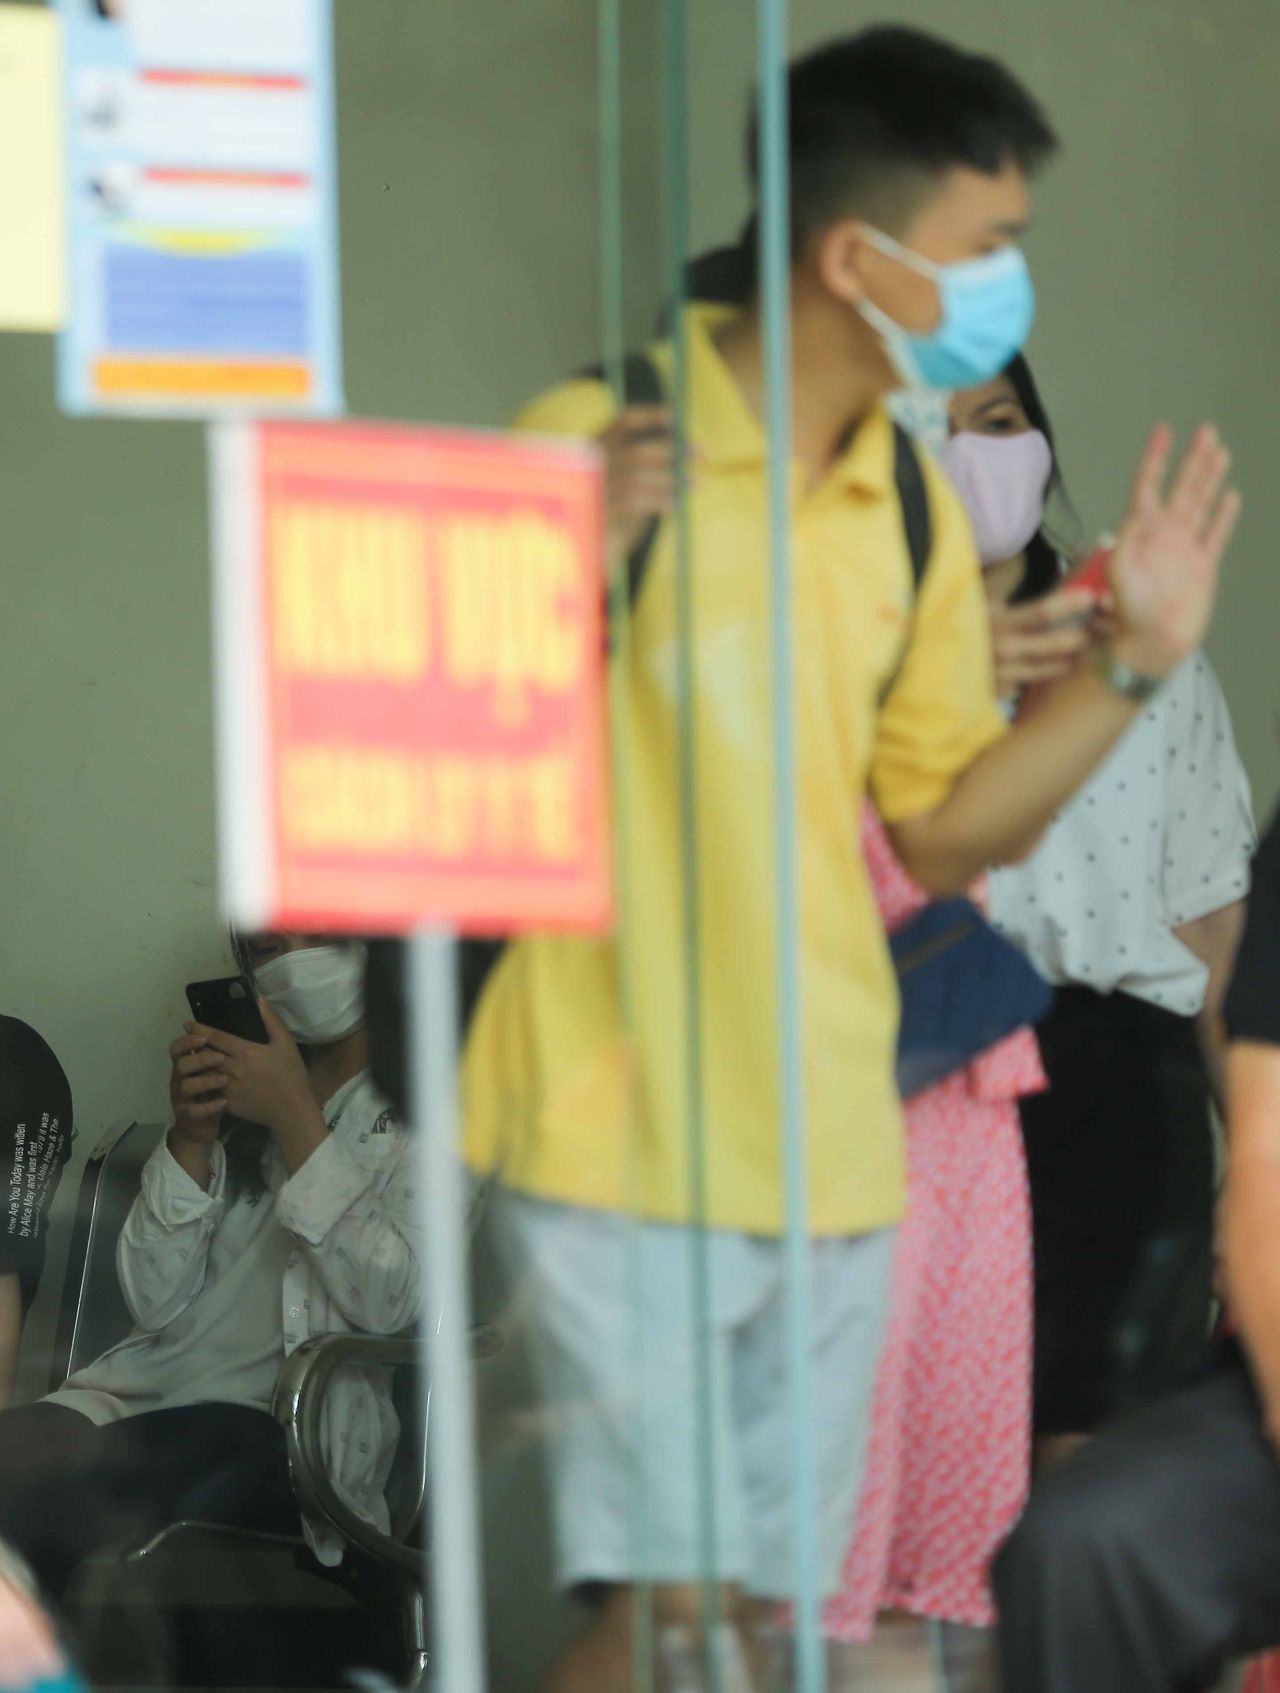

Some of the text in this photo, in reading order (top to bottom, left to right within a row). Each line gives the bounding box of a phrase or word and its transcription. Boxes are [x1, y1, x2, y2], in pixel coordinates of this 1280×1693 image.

[41, 1112, 49, 1128] was
[43, 1142, 55, 1163] Haze
[50, 1118, 59, 1134] The
[14, 1147, 24, 1162] was
[10, 1163, 25, 1185] Today
[9, 1187, 21, 1201] You
[18, 1141, 38, 1237] by Alice May and was first
[8, 1202, 19, 1217] Are
[7, 1216, 18, 1234] How
